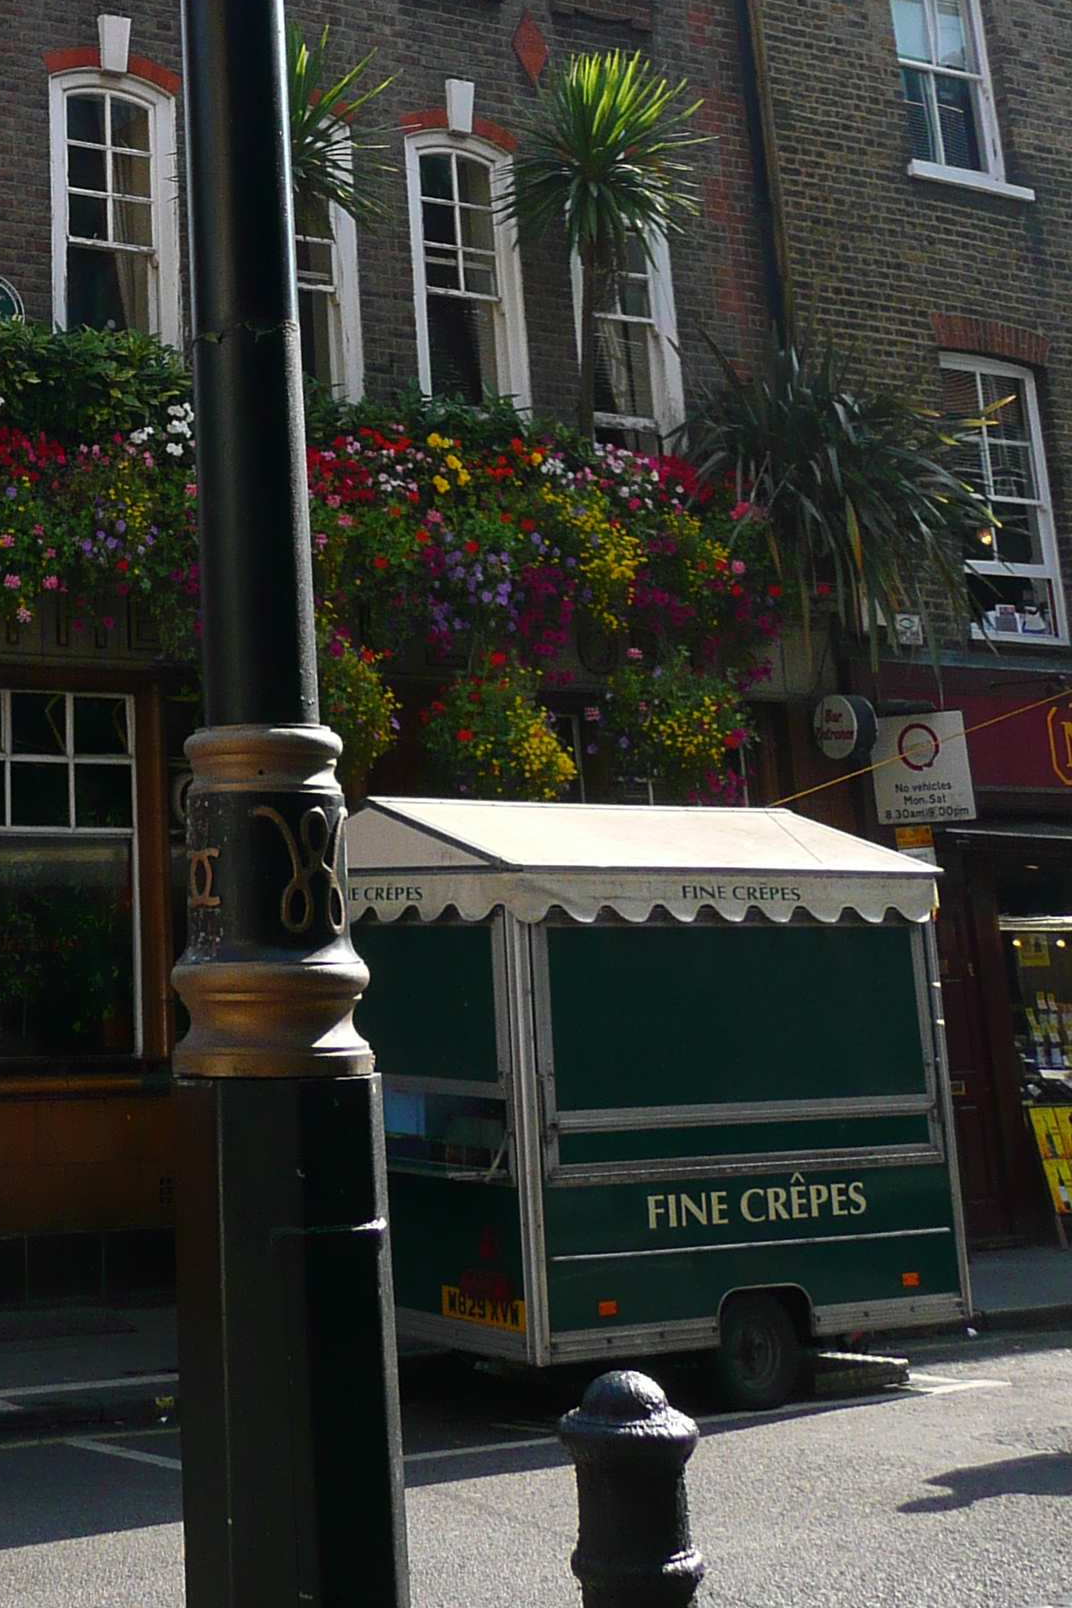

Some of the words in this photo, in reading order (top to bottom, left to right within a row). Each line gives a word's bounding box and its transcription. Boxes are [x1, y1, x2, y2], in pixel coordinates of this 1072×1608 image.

[895, 783, 909, 793] No
[912, 781, 952, 792] vehicles
[364, 882, 423, 901] CRÊPES
[682, 885, 726, 900] FINE
[732, 882, 801, 901] CRÊPES
[646, 1190, 729, 1229] FINE
[740, 1171, 867, 1223] CRÊPES
[447, 1290, 486, 1319] W829
